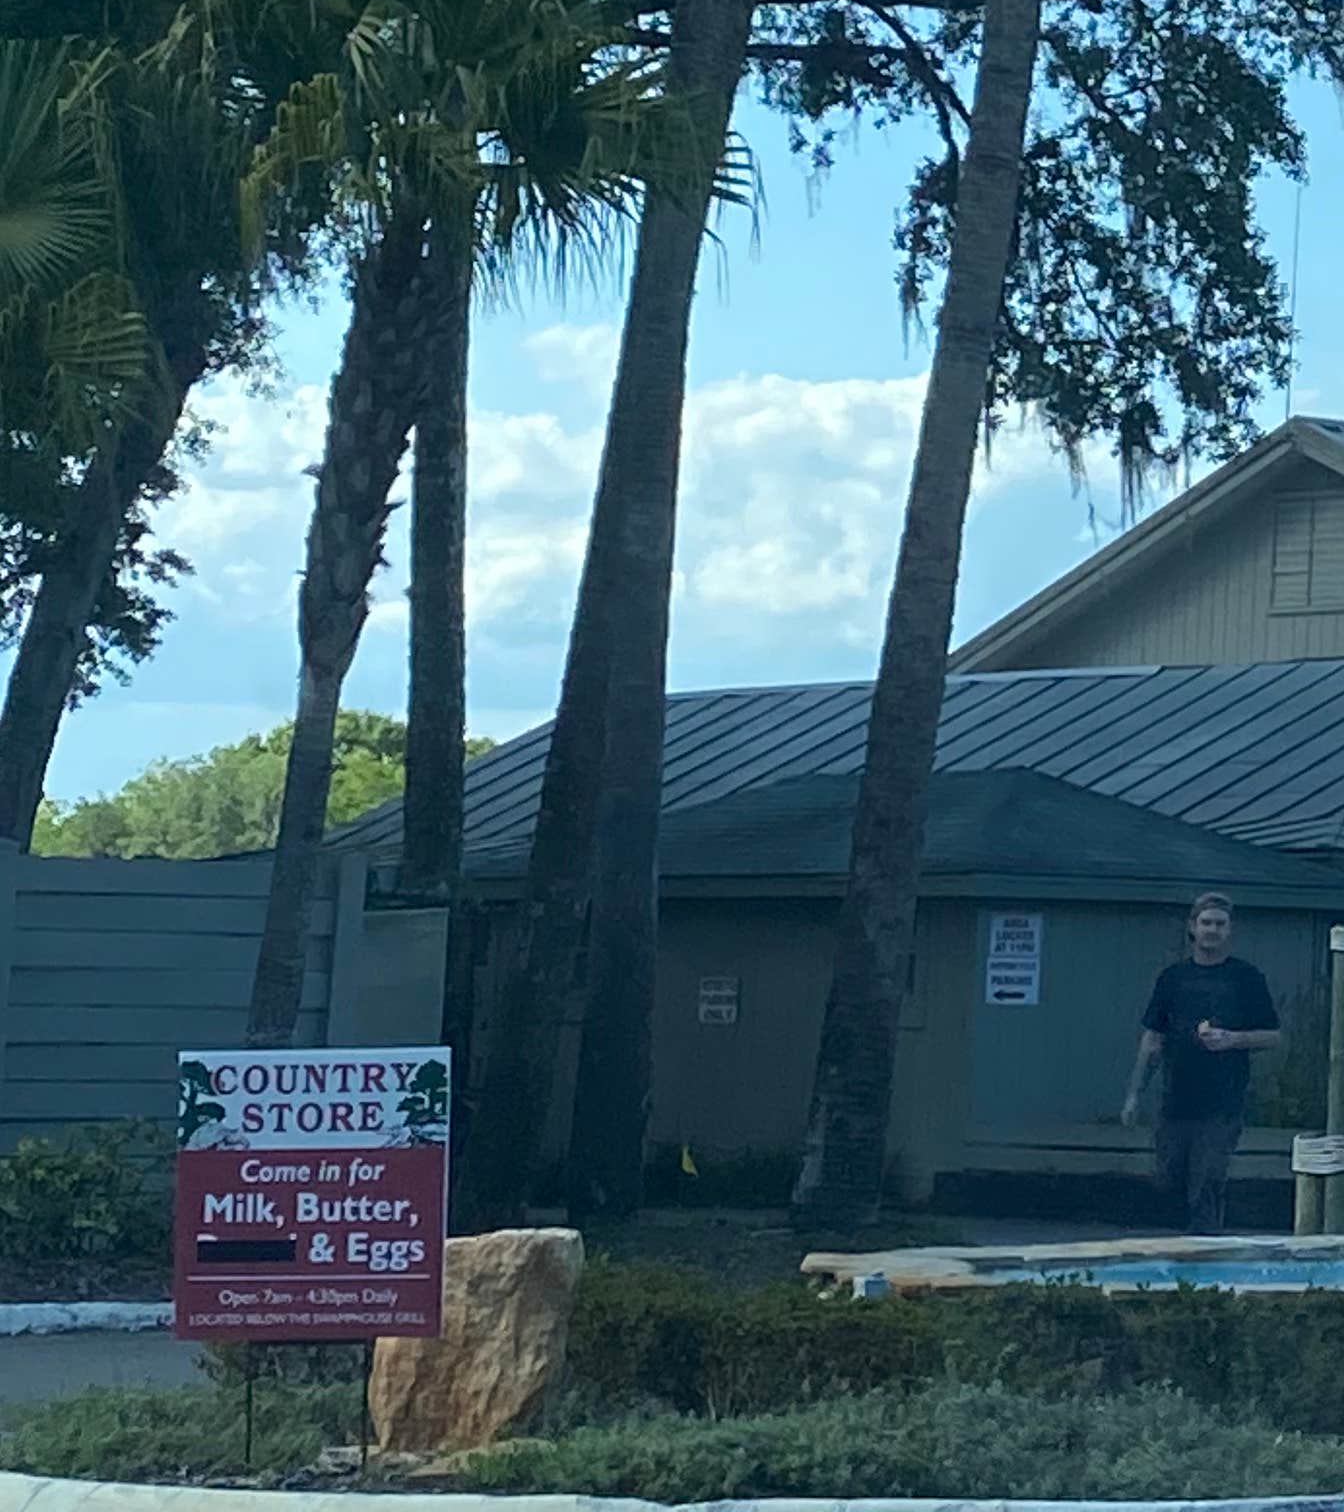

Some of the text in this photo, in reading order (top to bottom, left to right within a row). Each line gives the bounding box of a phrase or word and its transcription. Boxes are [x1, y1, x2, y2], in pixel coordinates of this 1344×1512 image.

[210, 1062, 419, 1096] COUNTRY
[241, 1101, 385, 1134] STORE
[240, 1157, 386, 1186] Come in for
[203, 1192, 419, 1228] Milk, Butter,
[308, 1232, 335, 1263] &
[347, 1232, 426, 1272] Eggs
[219, 1289, 259, 1308] Open
[362, 1288, 398, 1307] Daily
